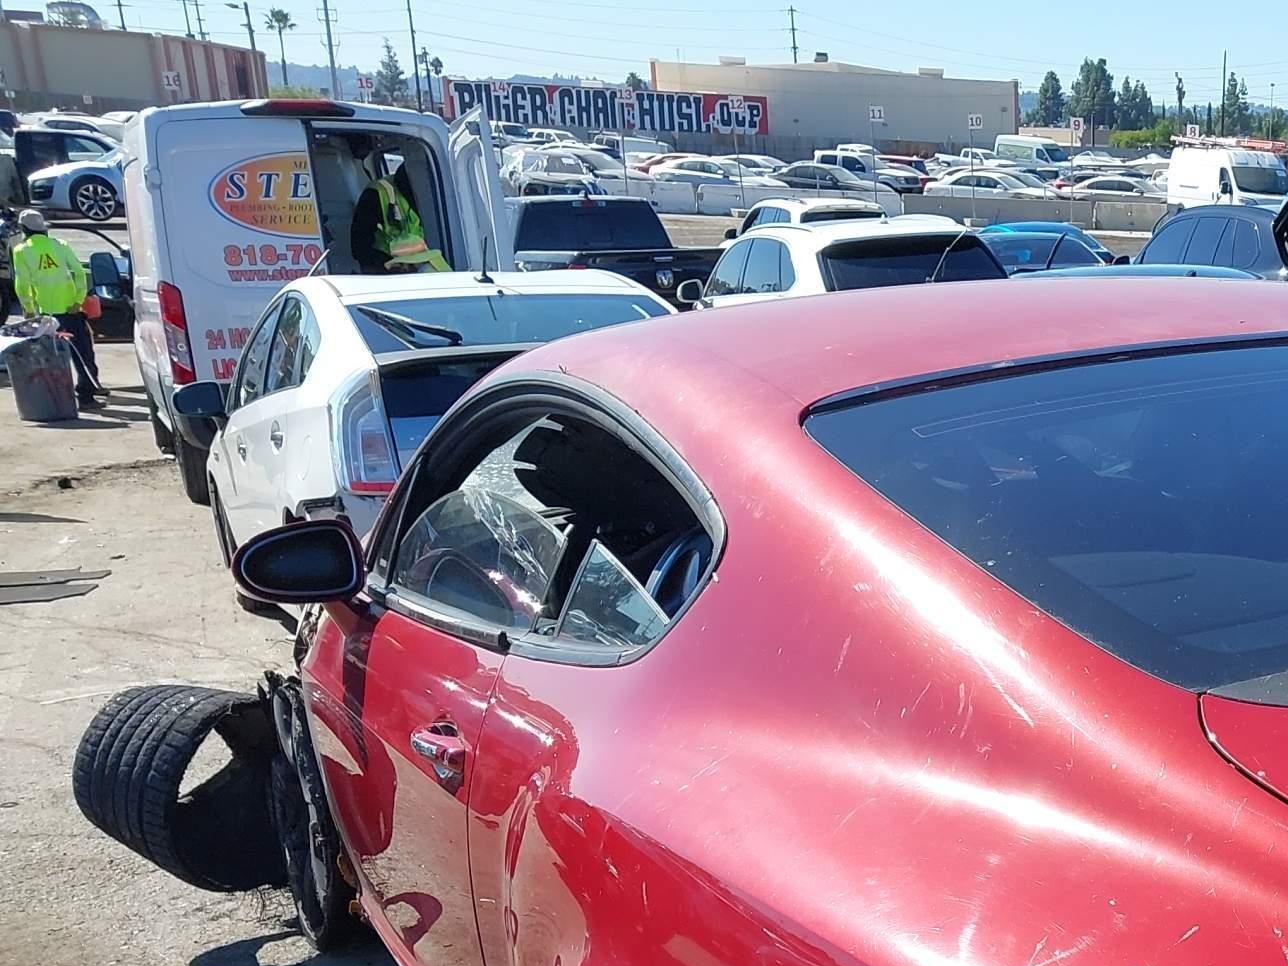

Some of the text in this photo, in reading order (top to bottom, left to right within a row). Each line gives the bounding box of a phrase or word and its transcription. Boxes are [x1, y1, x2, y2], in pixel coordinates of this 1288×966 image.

[165, 72, 181, 87] 16
[357, 77, 374, 89] 15
[492, 81, 506, 92] 14
[617, 88, 633, 100] 13
[729, 98, 744, 110] 12
[869, 108, 883, 119] 11
[969, 116, 982, 127] 10
[1072, 119, 1081, 131] 9
[1189, 126, 1197, 137] 8
[230, 203, 280, 212] PLUMBING
[223, 244, 322, 267] 818-70
[205, 328, 253, 350] 24 HO
